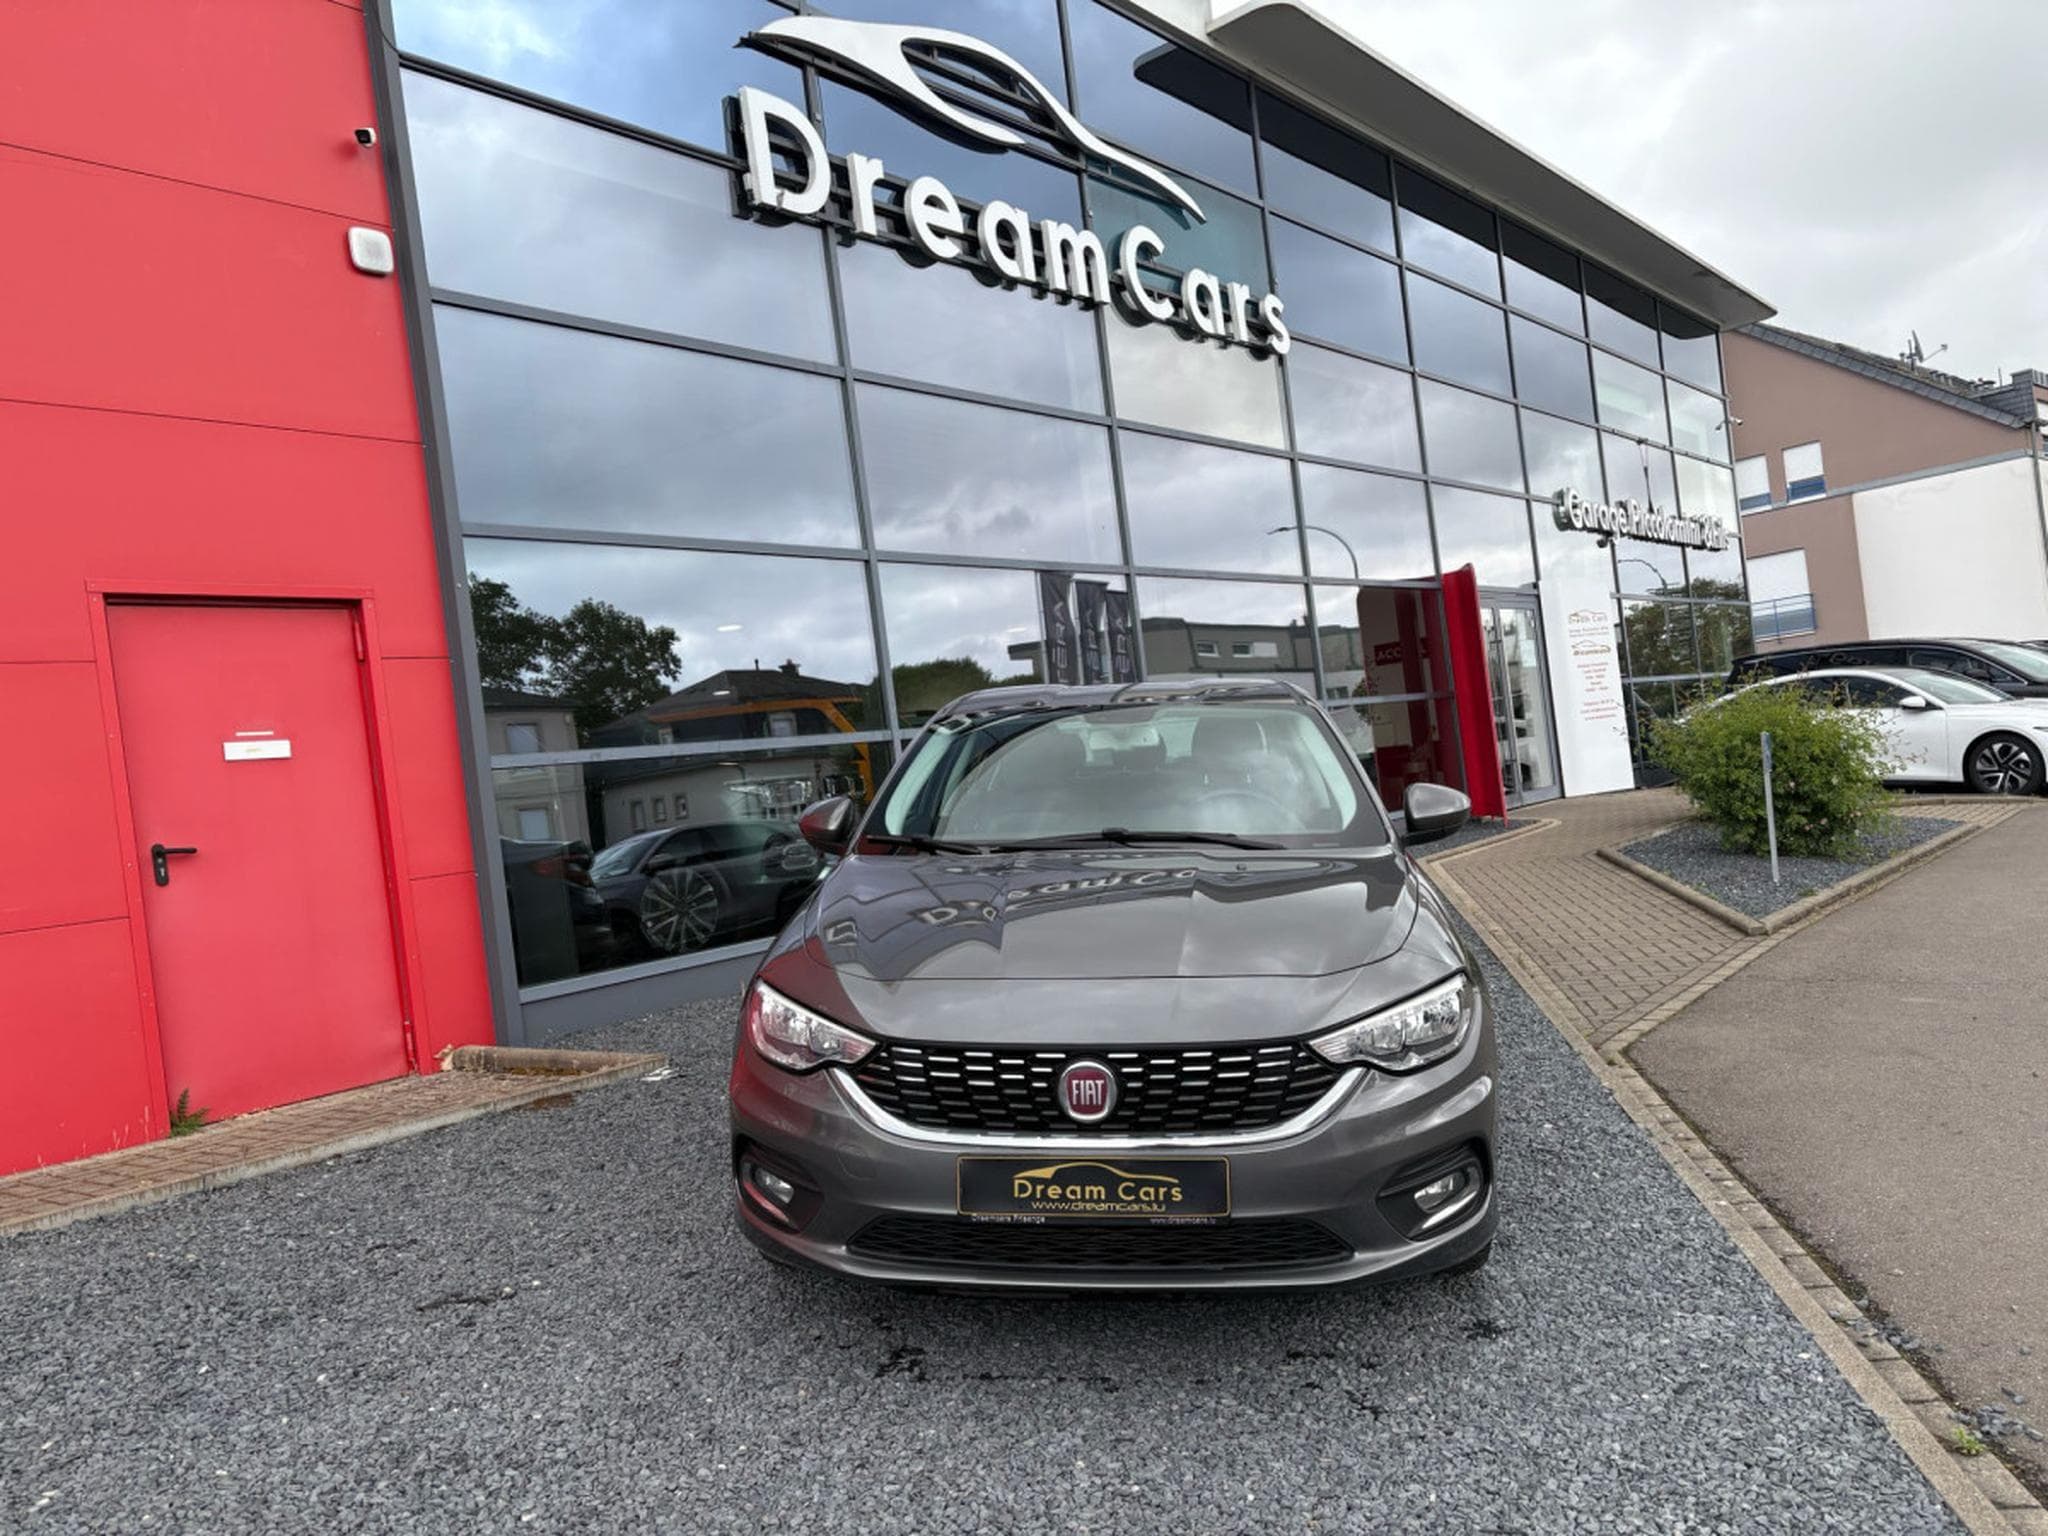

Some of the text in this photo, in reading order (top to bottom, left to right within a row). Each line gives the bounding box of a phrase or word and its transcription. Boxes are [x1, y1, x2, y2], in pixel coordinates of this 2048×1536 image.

[1567, 487, 1628, 543] Garage
[1071, 1079, 1105, 1105] FIAT
[1013, 1178, 1184, 1202] Dream Cars
[1032, 1201, 1167, 1212] www.dreamcars.lu
